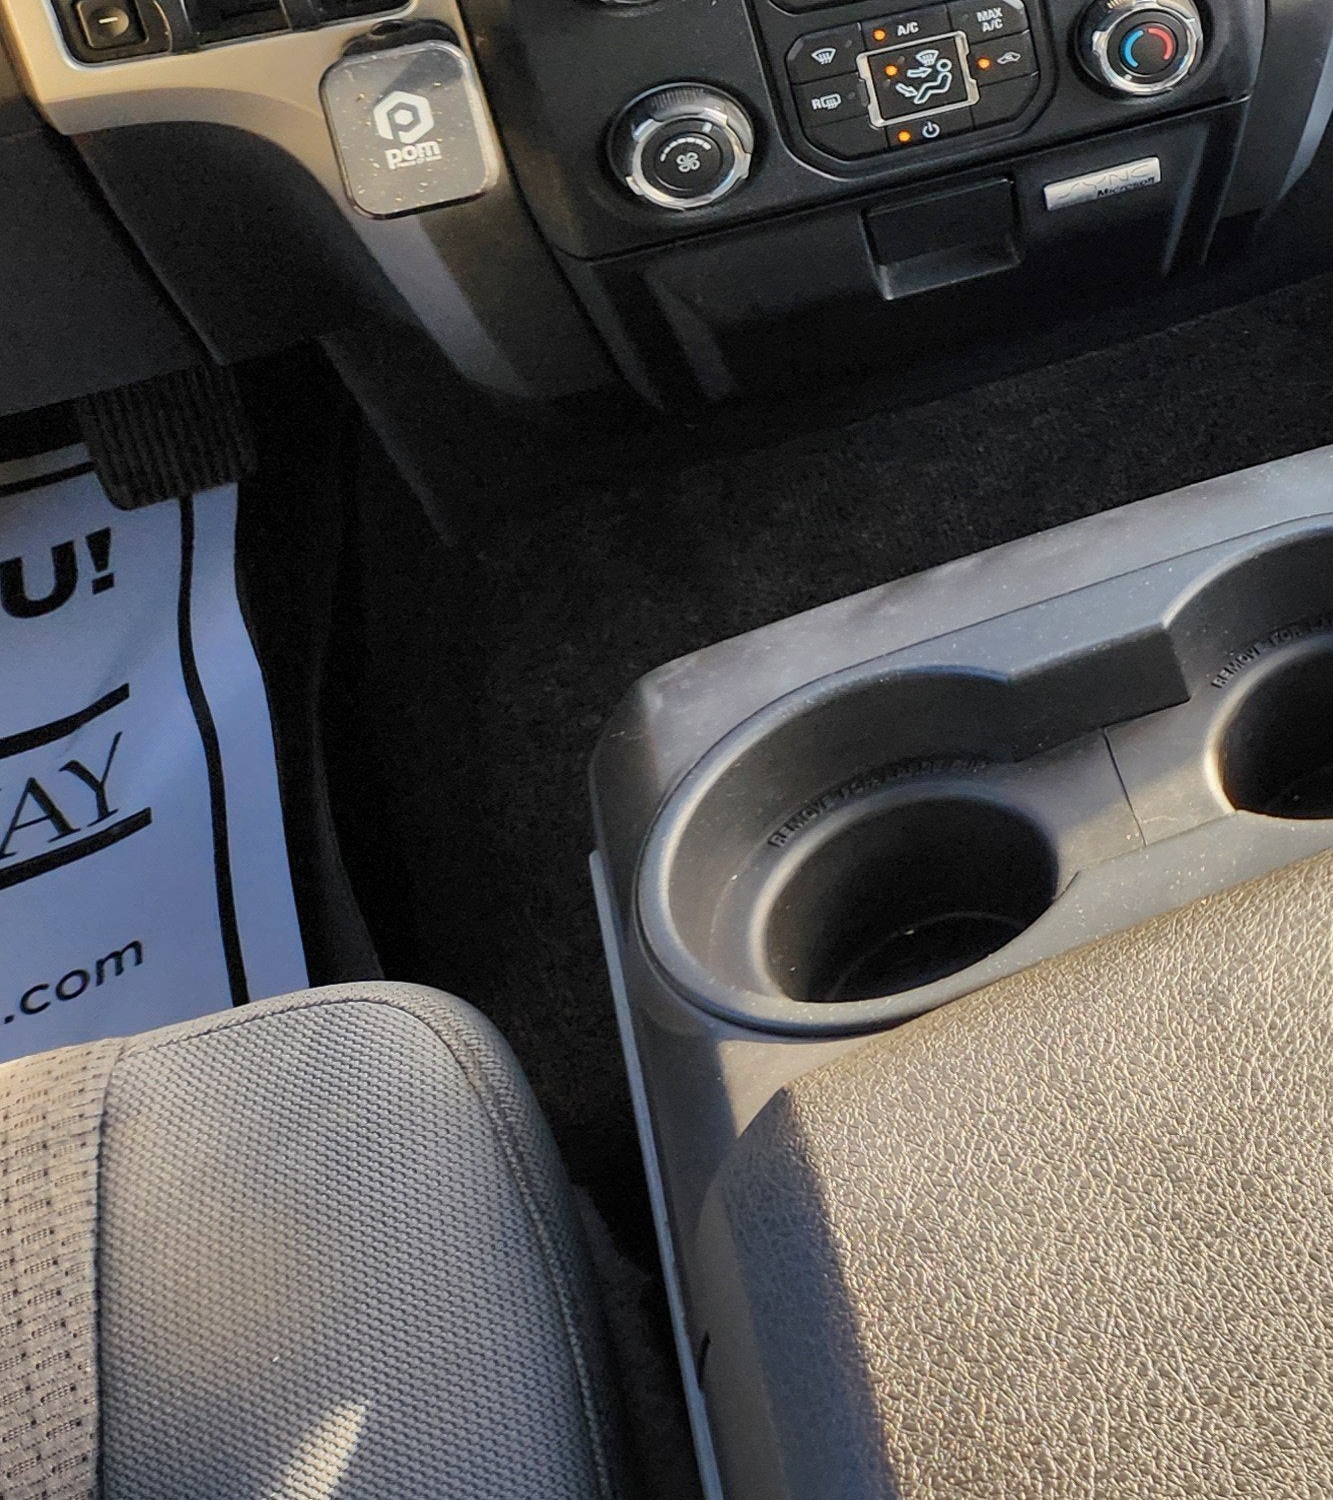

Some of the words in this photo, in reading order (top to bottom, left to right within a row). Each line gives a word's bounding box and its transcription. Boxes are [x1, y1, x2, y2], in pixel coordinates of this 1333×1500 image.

[976, 7, 1004, 22] MAX
[896, 21, 920, 37] A/C
[981, 17, 1004, 33] A/C
[384, 140, 442, 170] pom
[0, 730, 123, 859] AY
